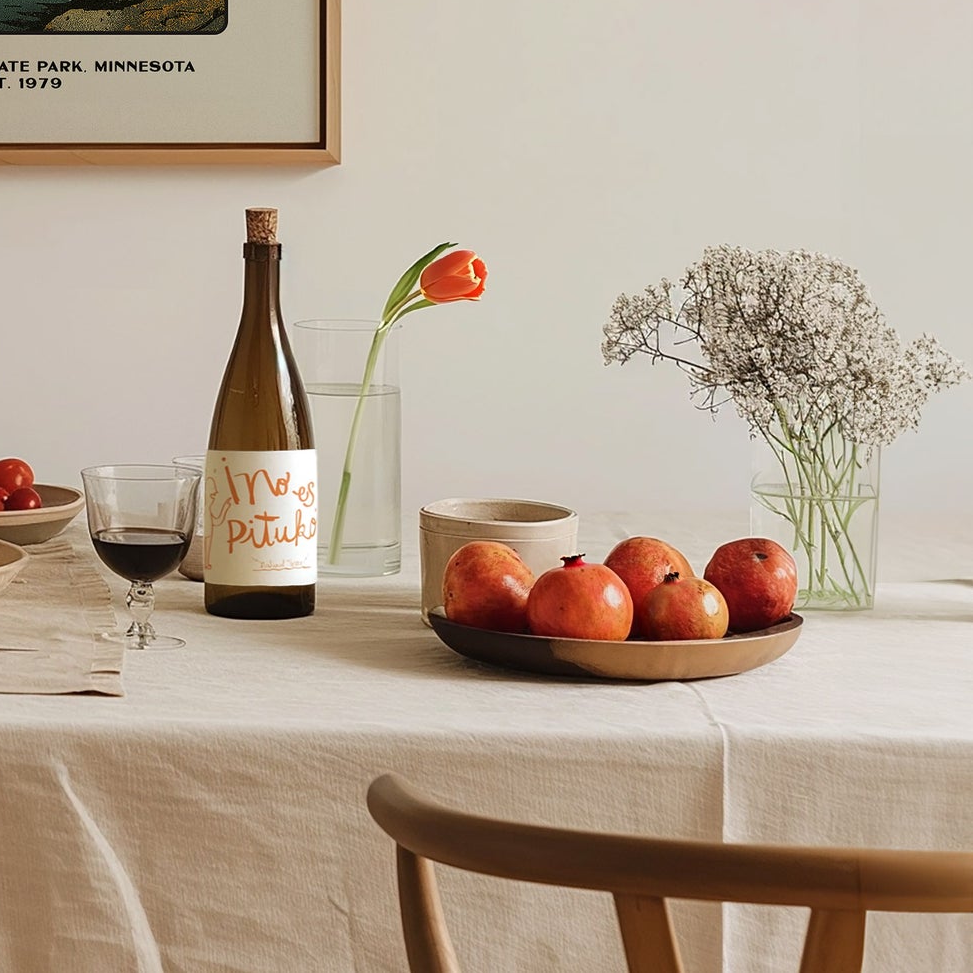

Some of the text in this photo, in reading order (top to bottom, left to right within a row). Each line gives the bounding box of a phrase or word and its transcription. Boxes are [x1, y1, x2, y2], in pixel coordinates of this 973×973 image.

[94, 60, 196, 73] MINNESOTA
[18, 77, 62, 89] 1979
[292, 481, 315, 508] es
